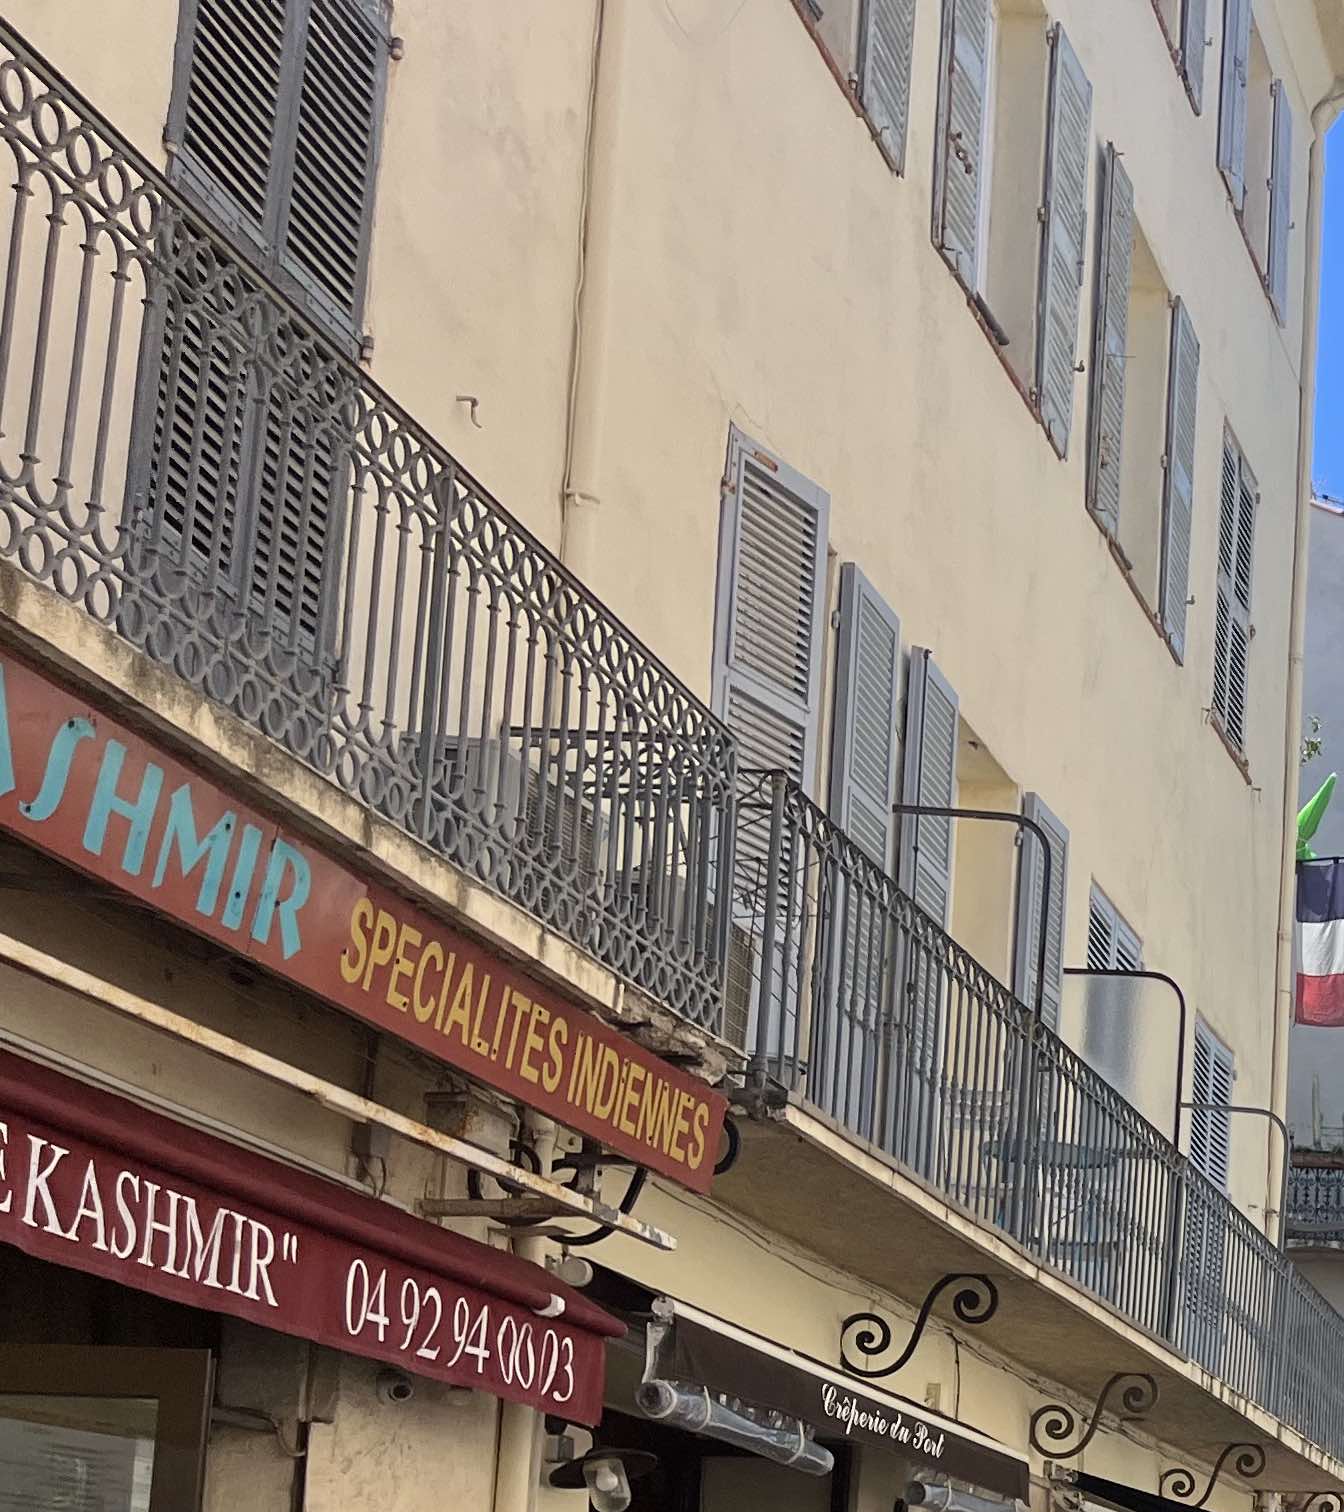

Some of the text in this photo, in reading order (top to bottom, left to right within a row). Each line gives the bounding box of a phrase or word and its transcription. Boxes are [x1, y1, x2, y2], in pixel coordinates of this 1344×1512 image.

[340, 897, 709, 1171] SPECIALITES INDIENNES
[346, 1258, 390, 1343] 04
[400, 1278, 442, 1361] 92
[447, 1297, 490, 1374] 94
[822, 1383, 944, 1459] Crêperie du Port
